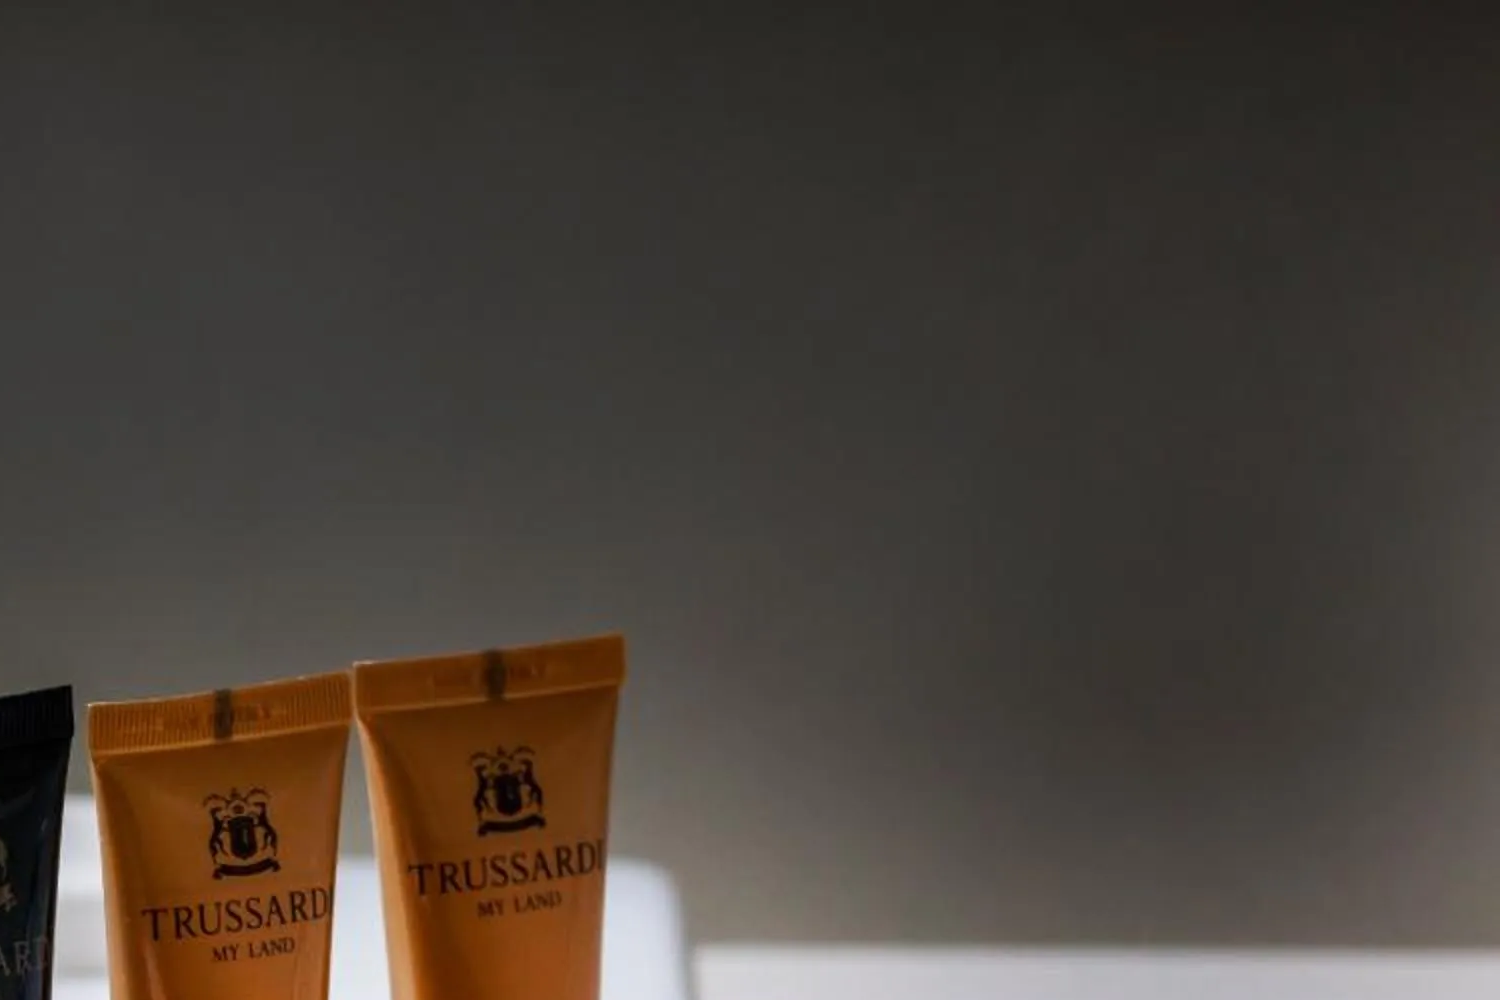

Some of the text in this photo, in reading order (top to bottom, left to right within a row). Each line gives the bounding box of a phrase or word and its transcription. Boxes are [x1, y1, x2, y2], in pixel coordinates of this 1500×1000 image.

[478, 892, 562, 917] MY LAND
[212, 937, 296, 963] MY LAND
